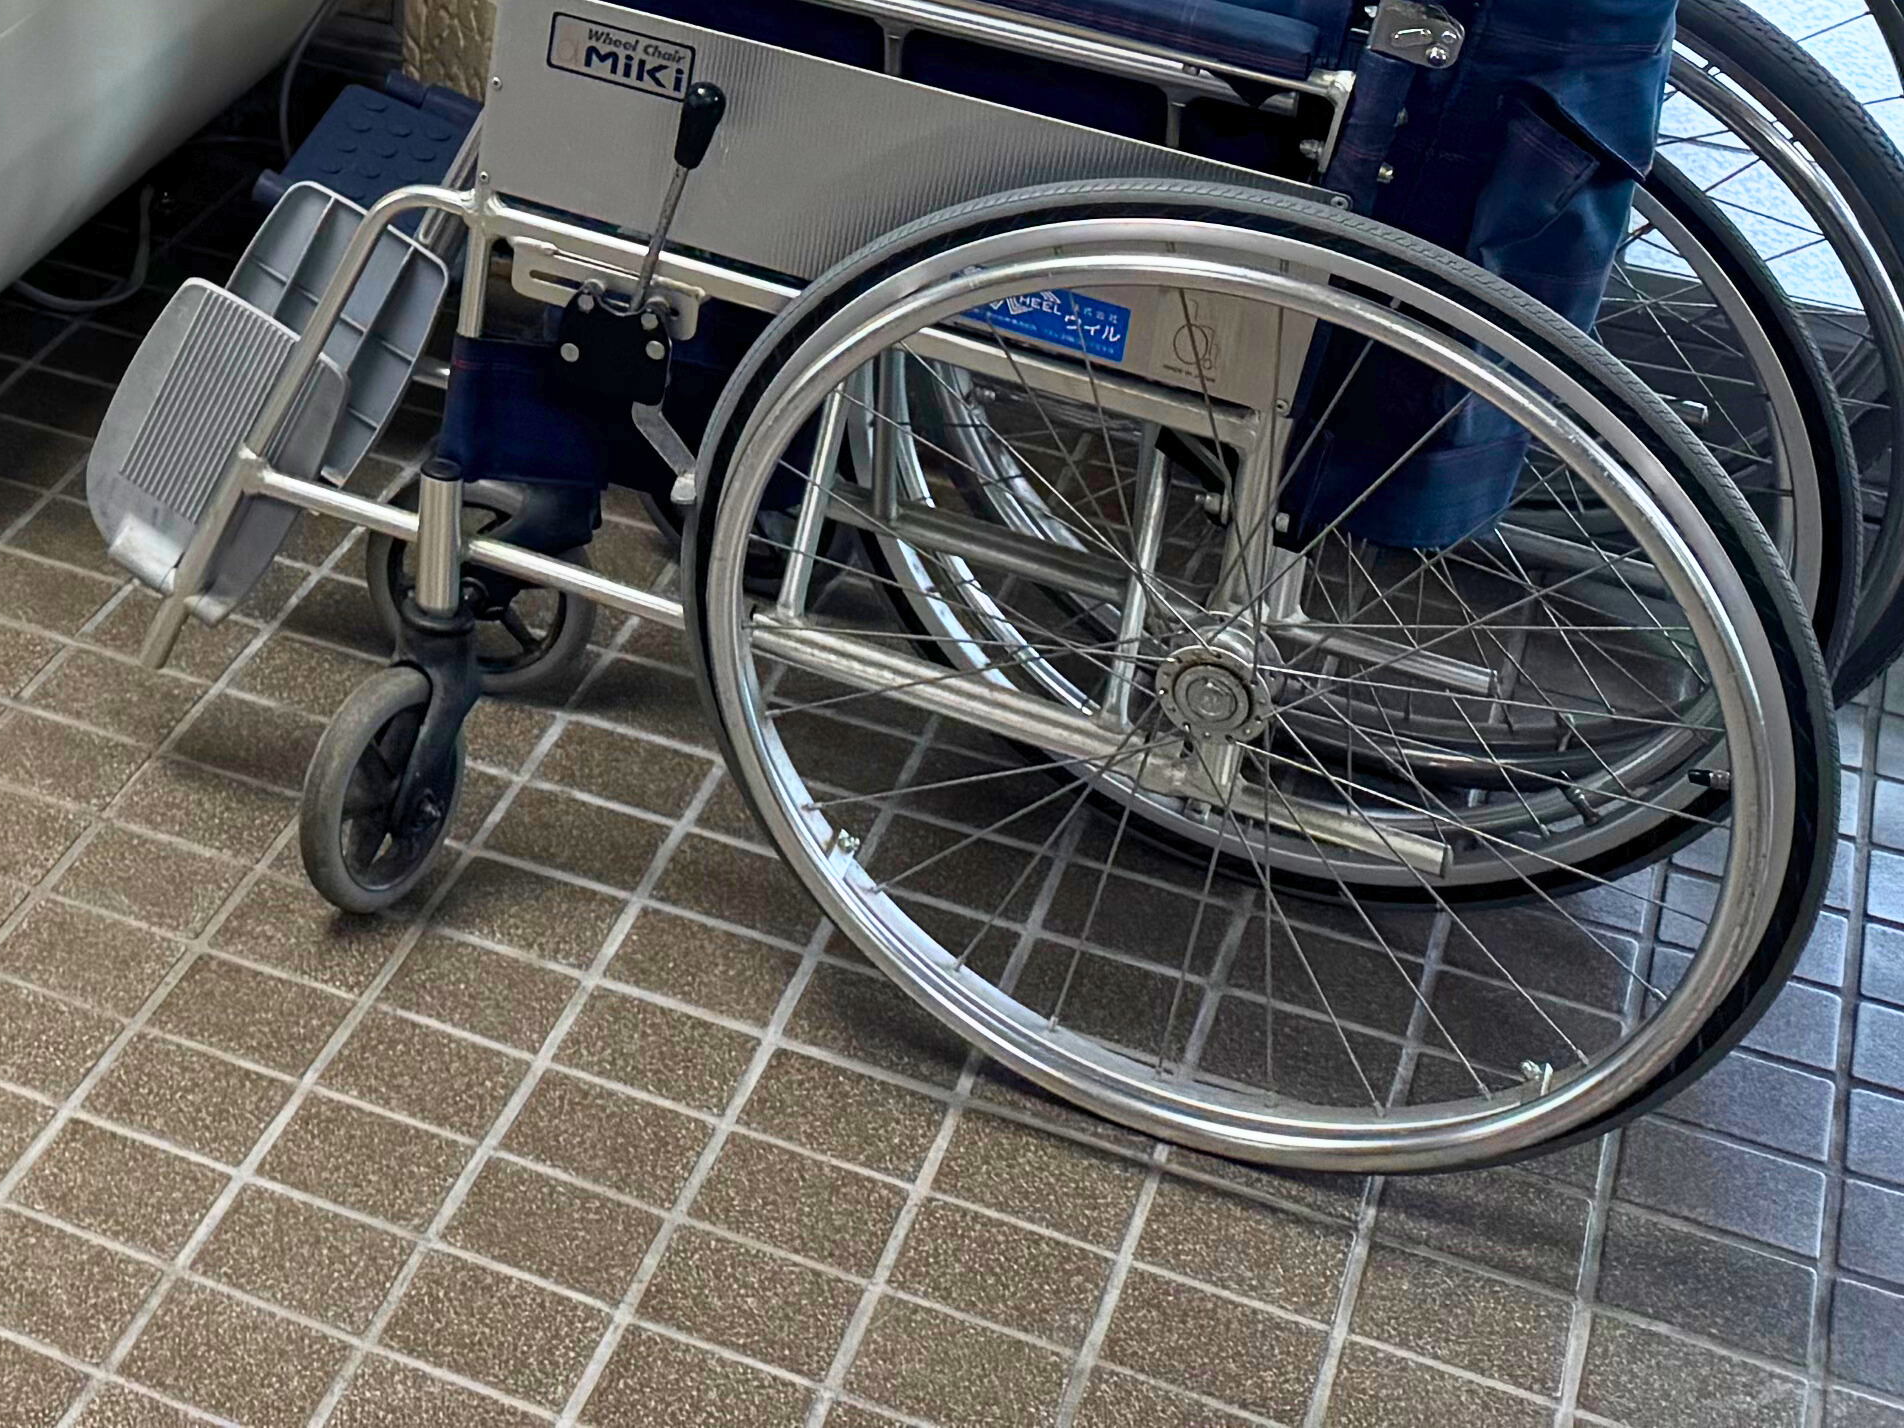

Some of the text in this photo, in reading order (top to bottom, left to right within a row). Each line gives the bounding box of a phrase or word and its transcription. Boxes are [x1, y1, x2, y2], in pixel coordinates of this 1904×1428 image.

[587, 27, 686, 64] Wheel Chair
[583, 45, 685, 93] MiKi
